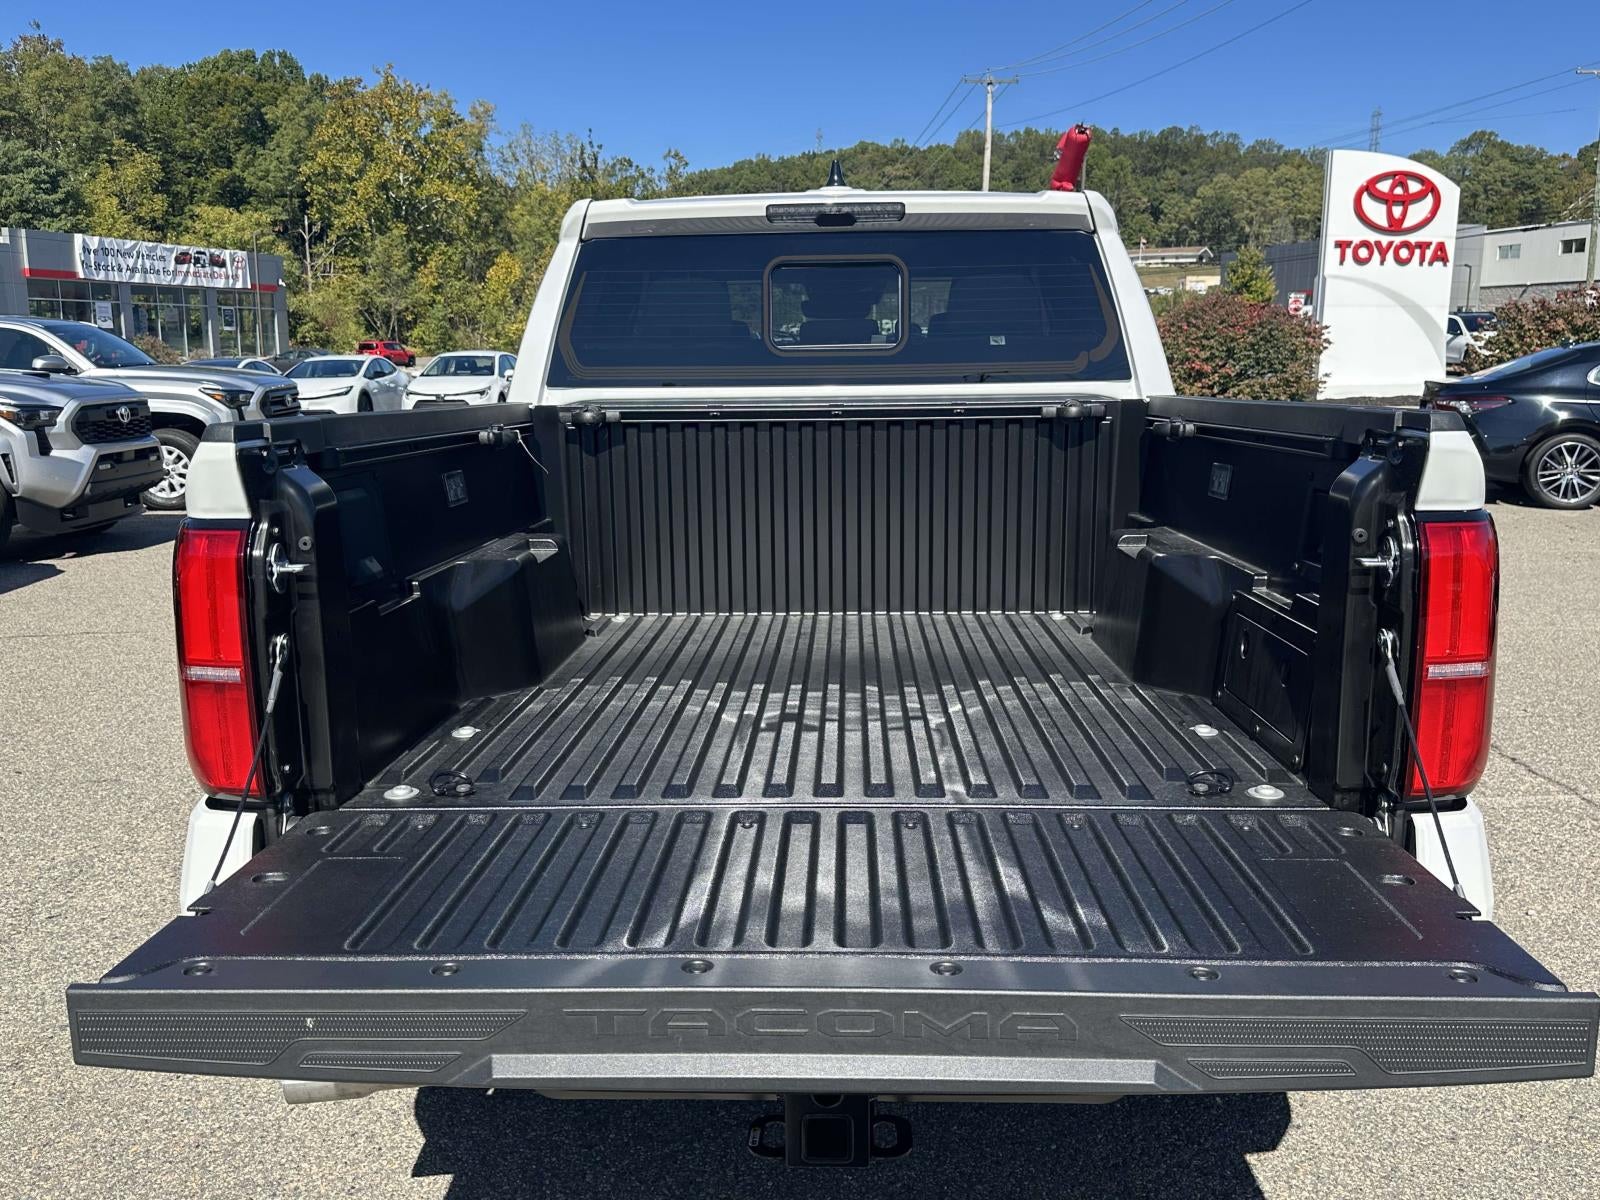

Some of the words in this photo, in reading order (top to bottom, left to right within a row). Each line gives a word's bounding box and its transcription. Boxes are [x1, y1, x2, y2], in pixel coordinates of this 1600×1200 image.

[101, 247, 115, 257] 100
[116, 248, 134, 259] New
[136, 249, 167, 262] Vehicles
[1334, 240, 1449, 266] TOYOTA
[117, 263, 123, 272] &
[126, 264, 161, 276] Available
[162, 267, 175, 277] For
[562, 1007, 1079, 1041] TACOMA
